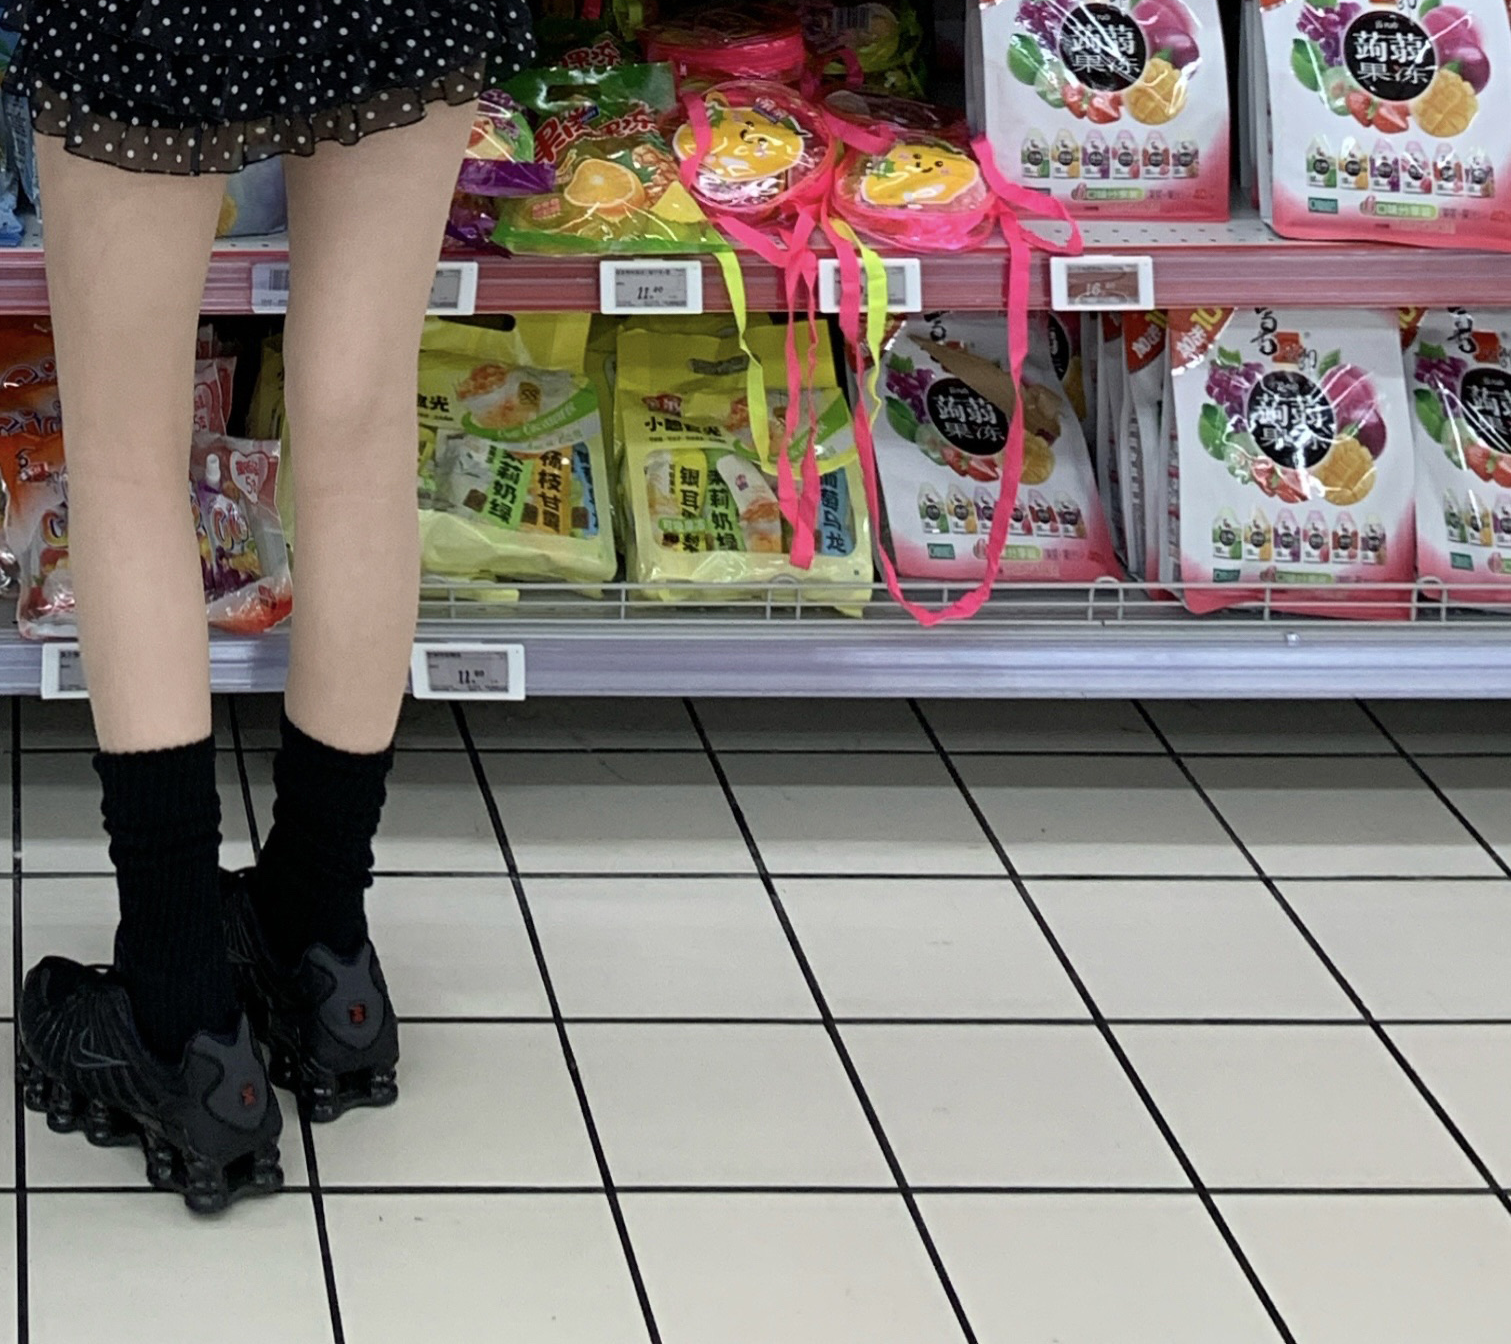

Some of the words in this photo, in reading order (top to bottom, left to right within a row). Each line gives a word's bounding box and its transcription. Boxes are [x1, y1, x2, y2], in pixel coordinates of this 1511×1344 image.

[1353, 31, 1423, 63] 蒟蒻
[1357, 62, 1428, 85] 果冻
[936, 395, 998, 423] 蒟蒻
[945, 420, 1006, 442] 果冻
